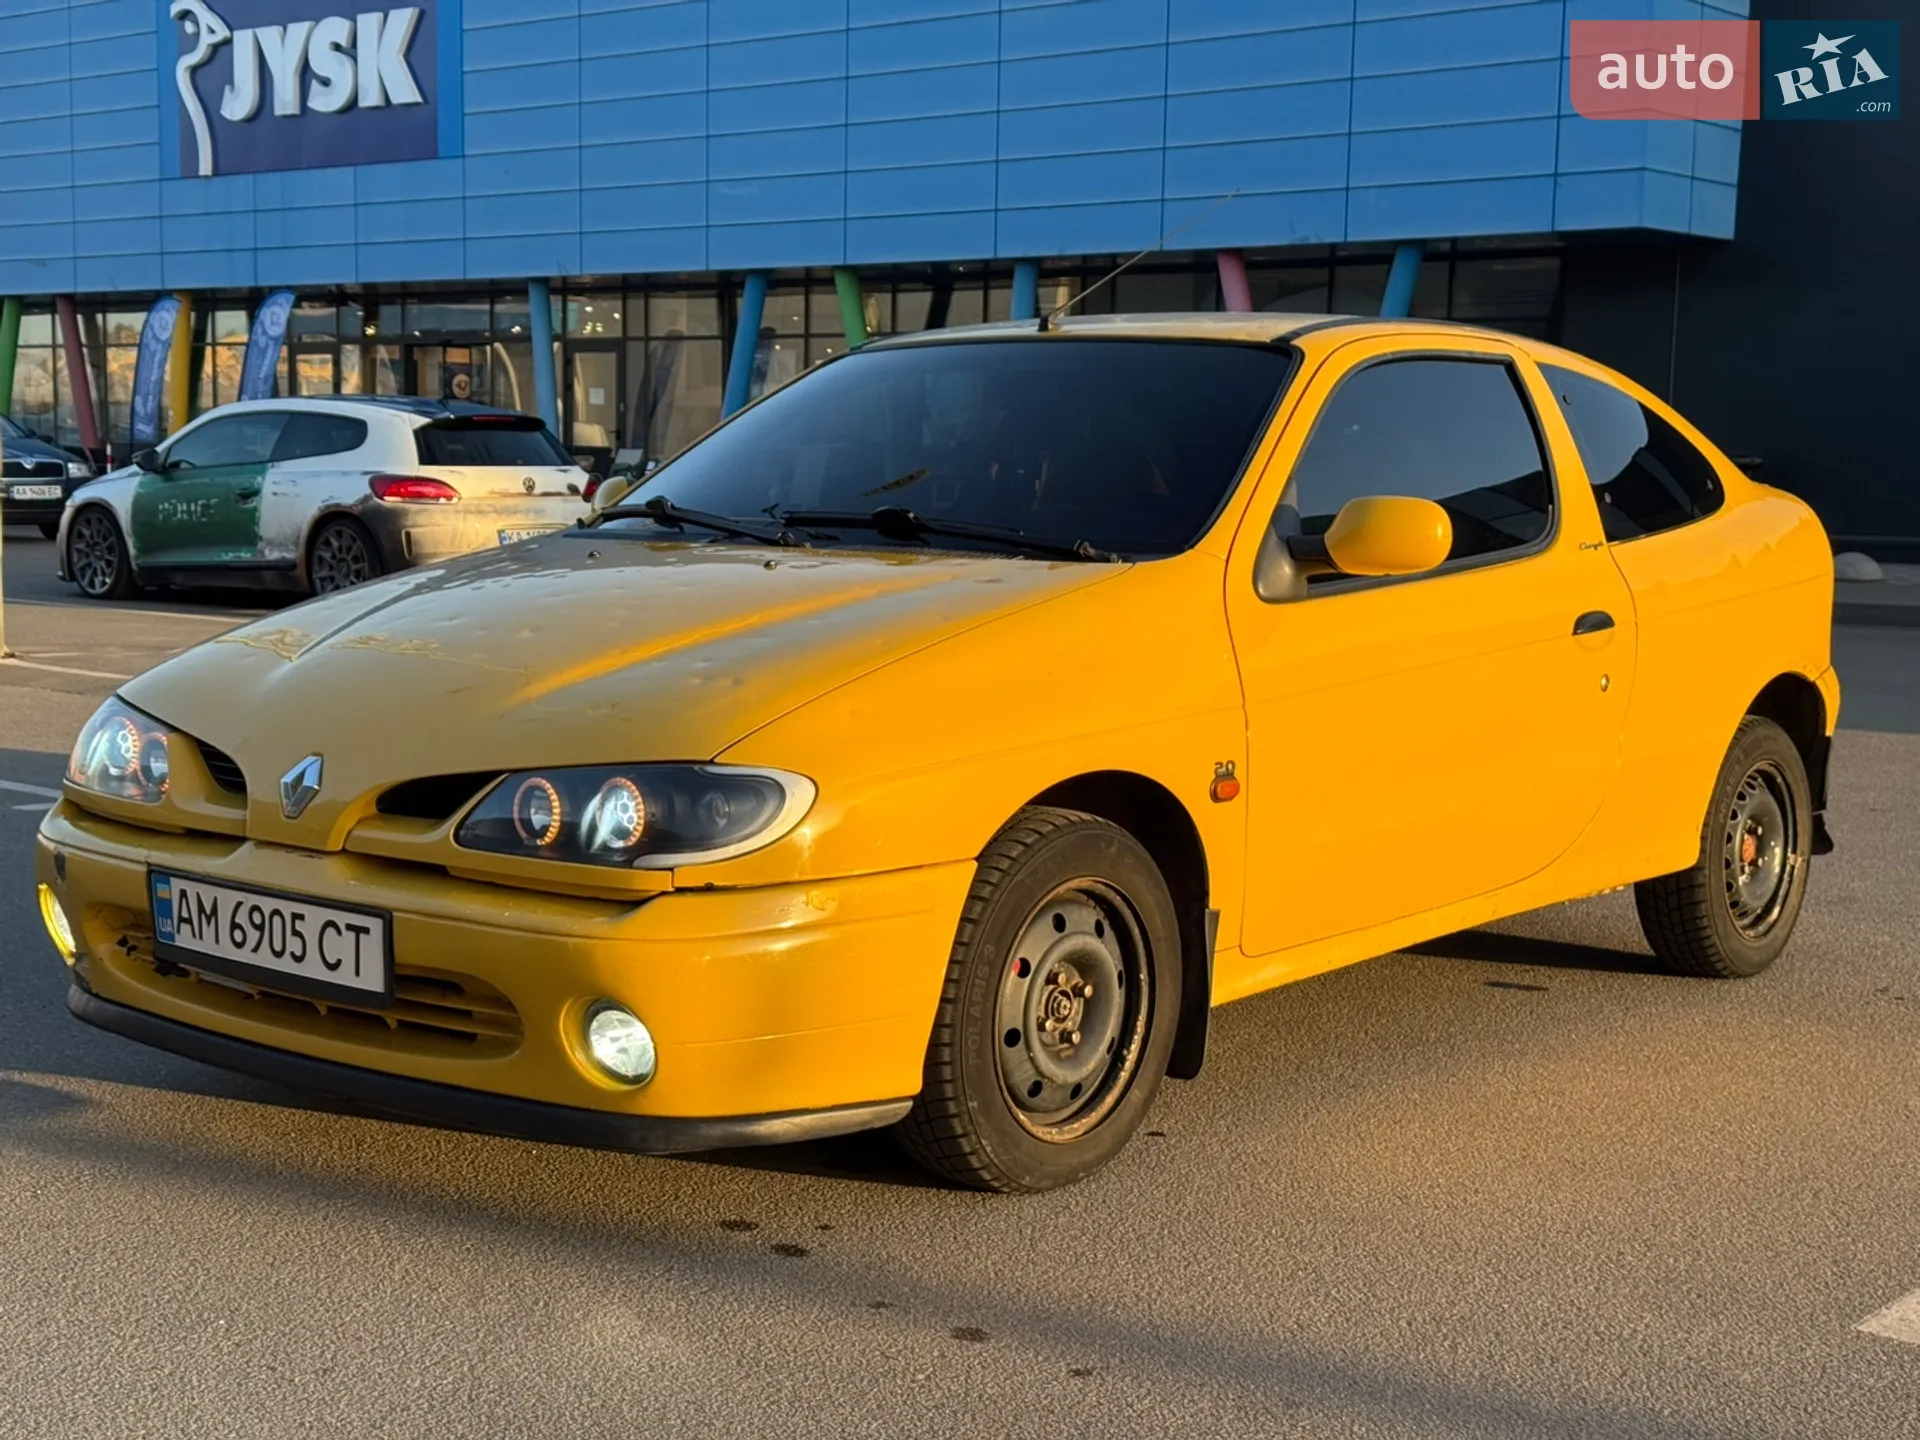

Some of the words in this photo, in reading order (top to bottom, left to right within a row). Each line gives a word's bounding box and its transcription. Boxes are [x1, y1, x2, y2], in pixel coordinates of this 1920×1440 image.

[220, 7, 423, 121] JYSK
[158, 917, 174, 934] UA
[176, 888, 219, 945] AM
[229, 901, 307, 963] 6905
[318, 919, 371, 977] CT
